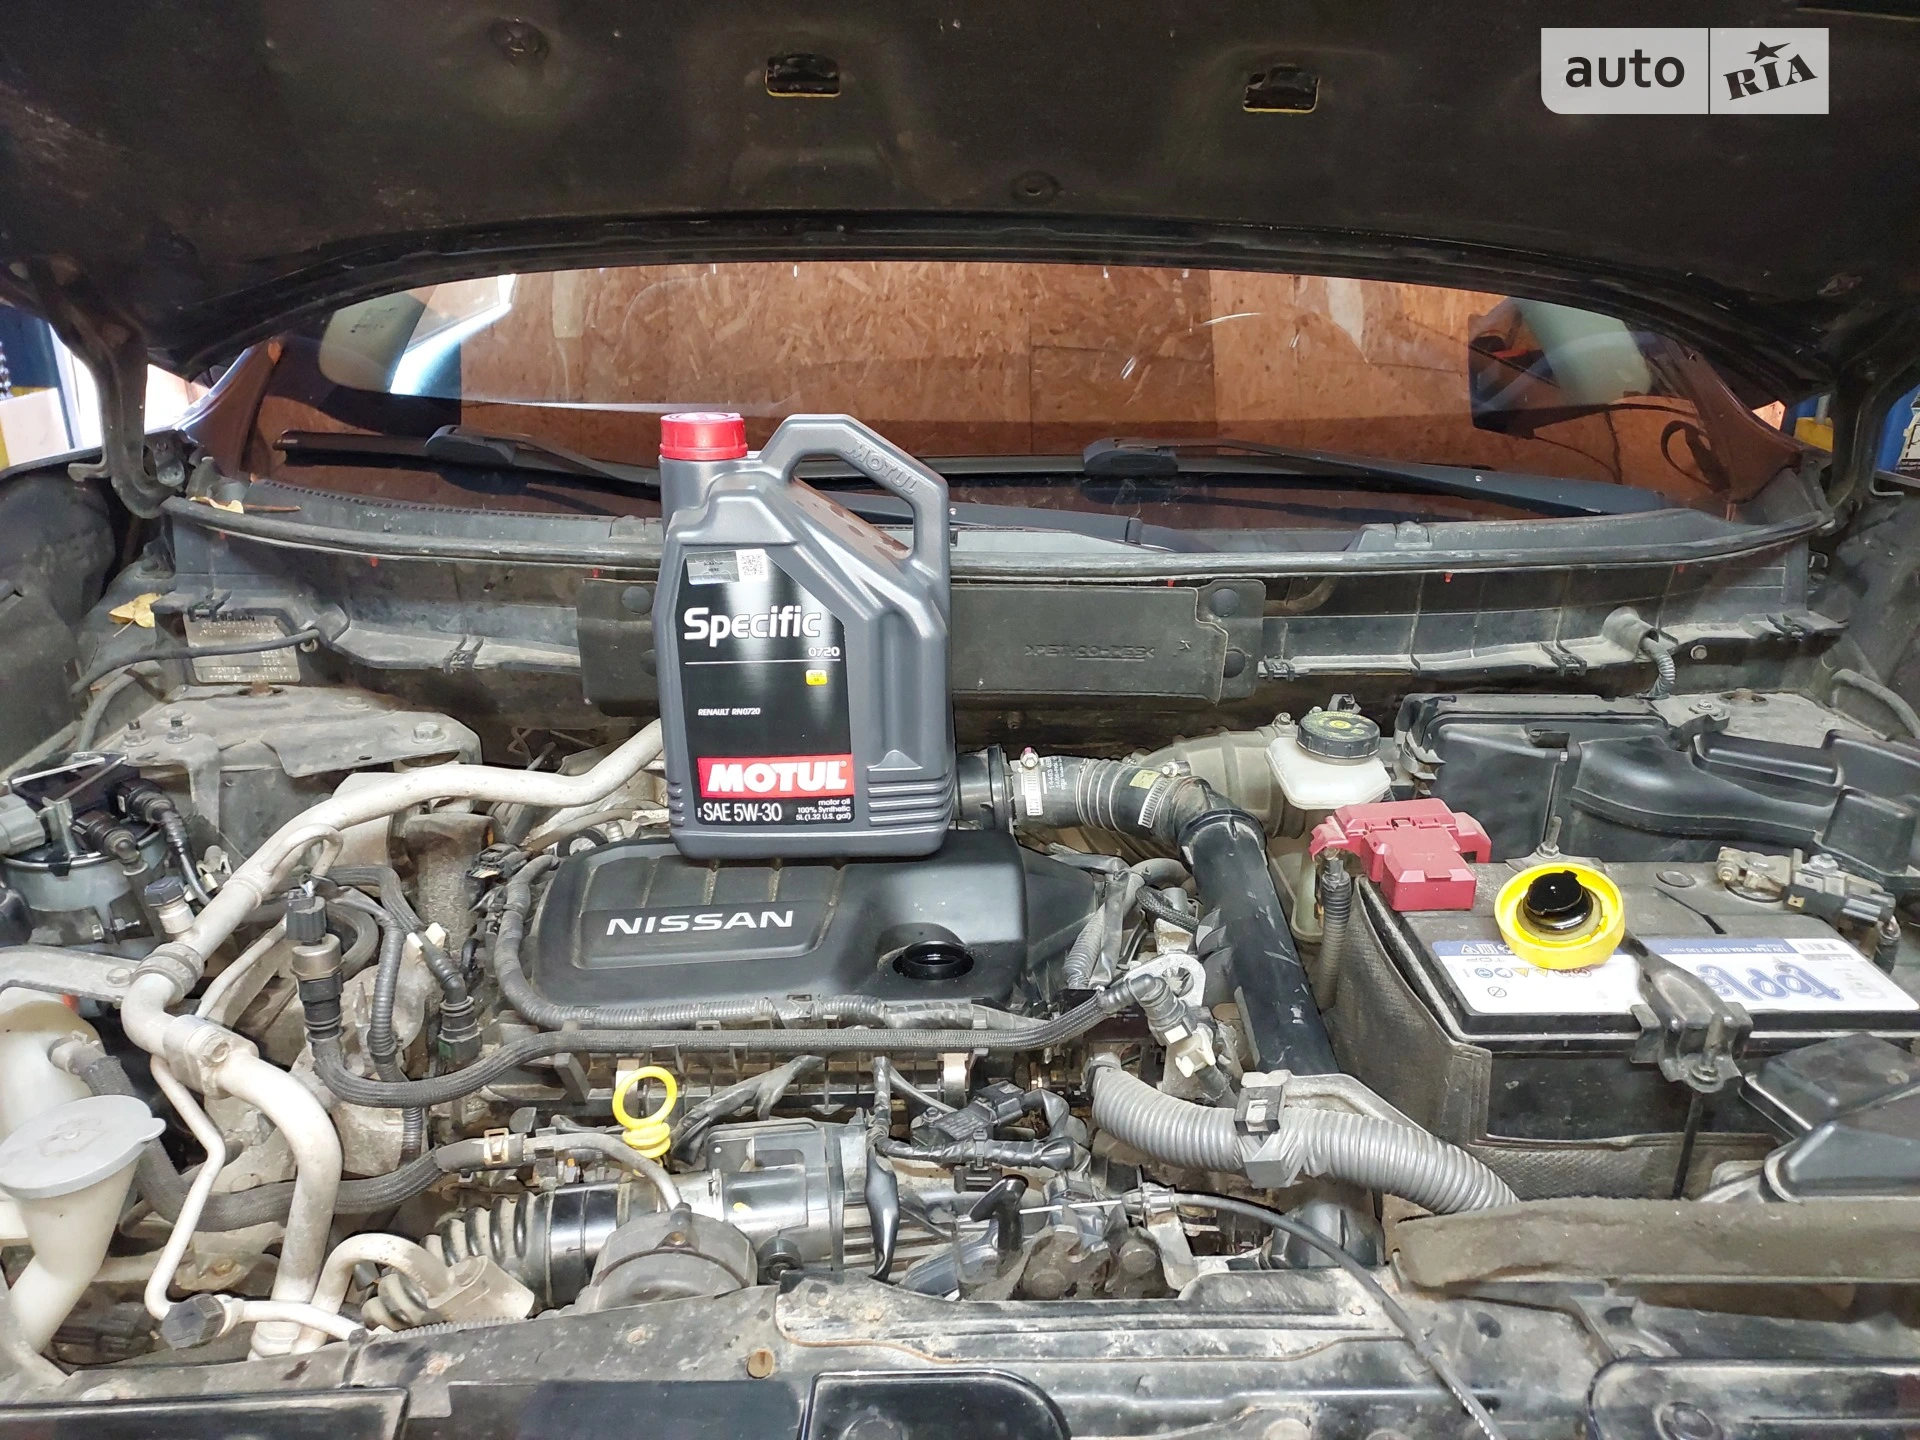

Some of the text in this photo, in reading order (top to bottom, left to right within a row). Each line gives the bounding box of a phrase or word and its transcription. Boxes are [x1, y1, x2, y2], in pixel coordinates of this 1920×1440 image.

[845, 440, 918, 495] MOTUL
[683, 605, 822, 648] Specific
[808, 646, 840, 657] 0720
[698, 707, 761, 716] RENAULT RN0720
[707, 760, 848, 793] MOTUL
[703, 802, 731, 821] SAE
[733, 802, 782, 822] 5W-30
[797, 805, 851, 814] 100% Synthetic
[605, 910, 794, 936] NISSAN
